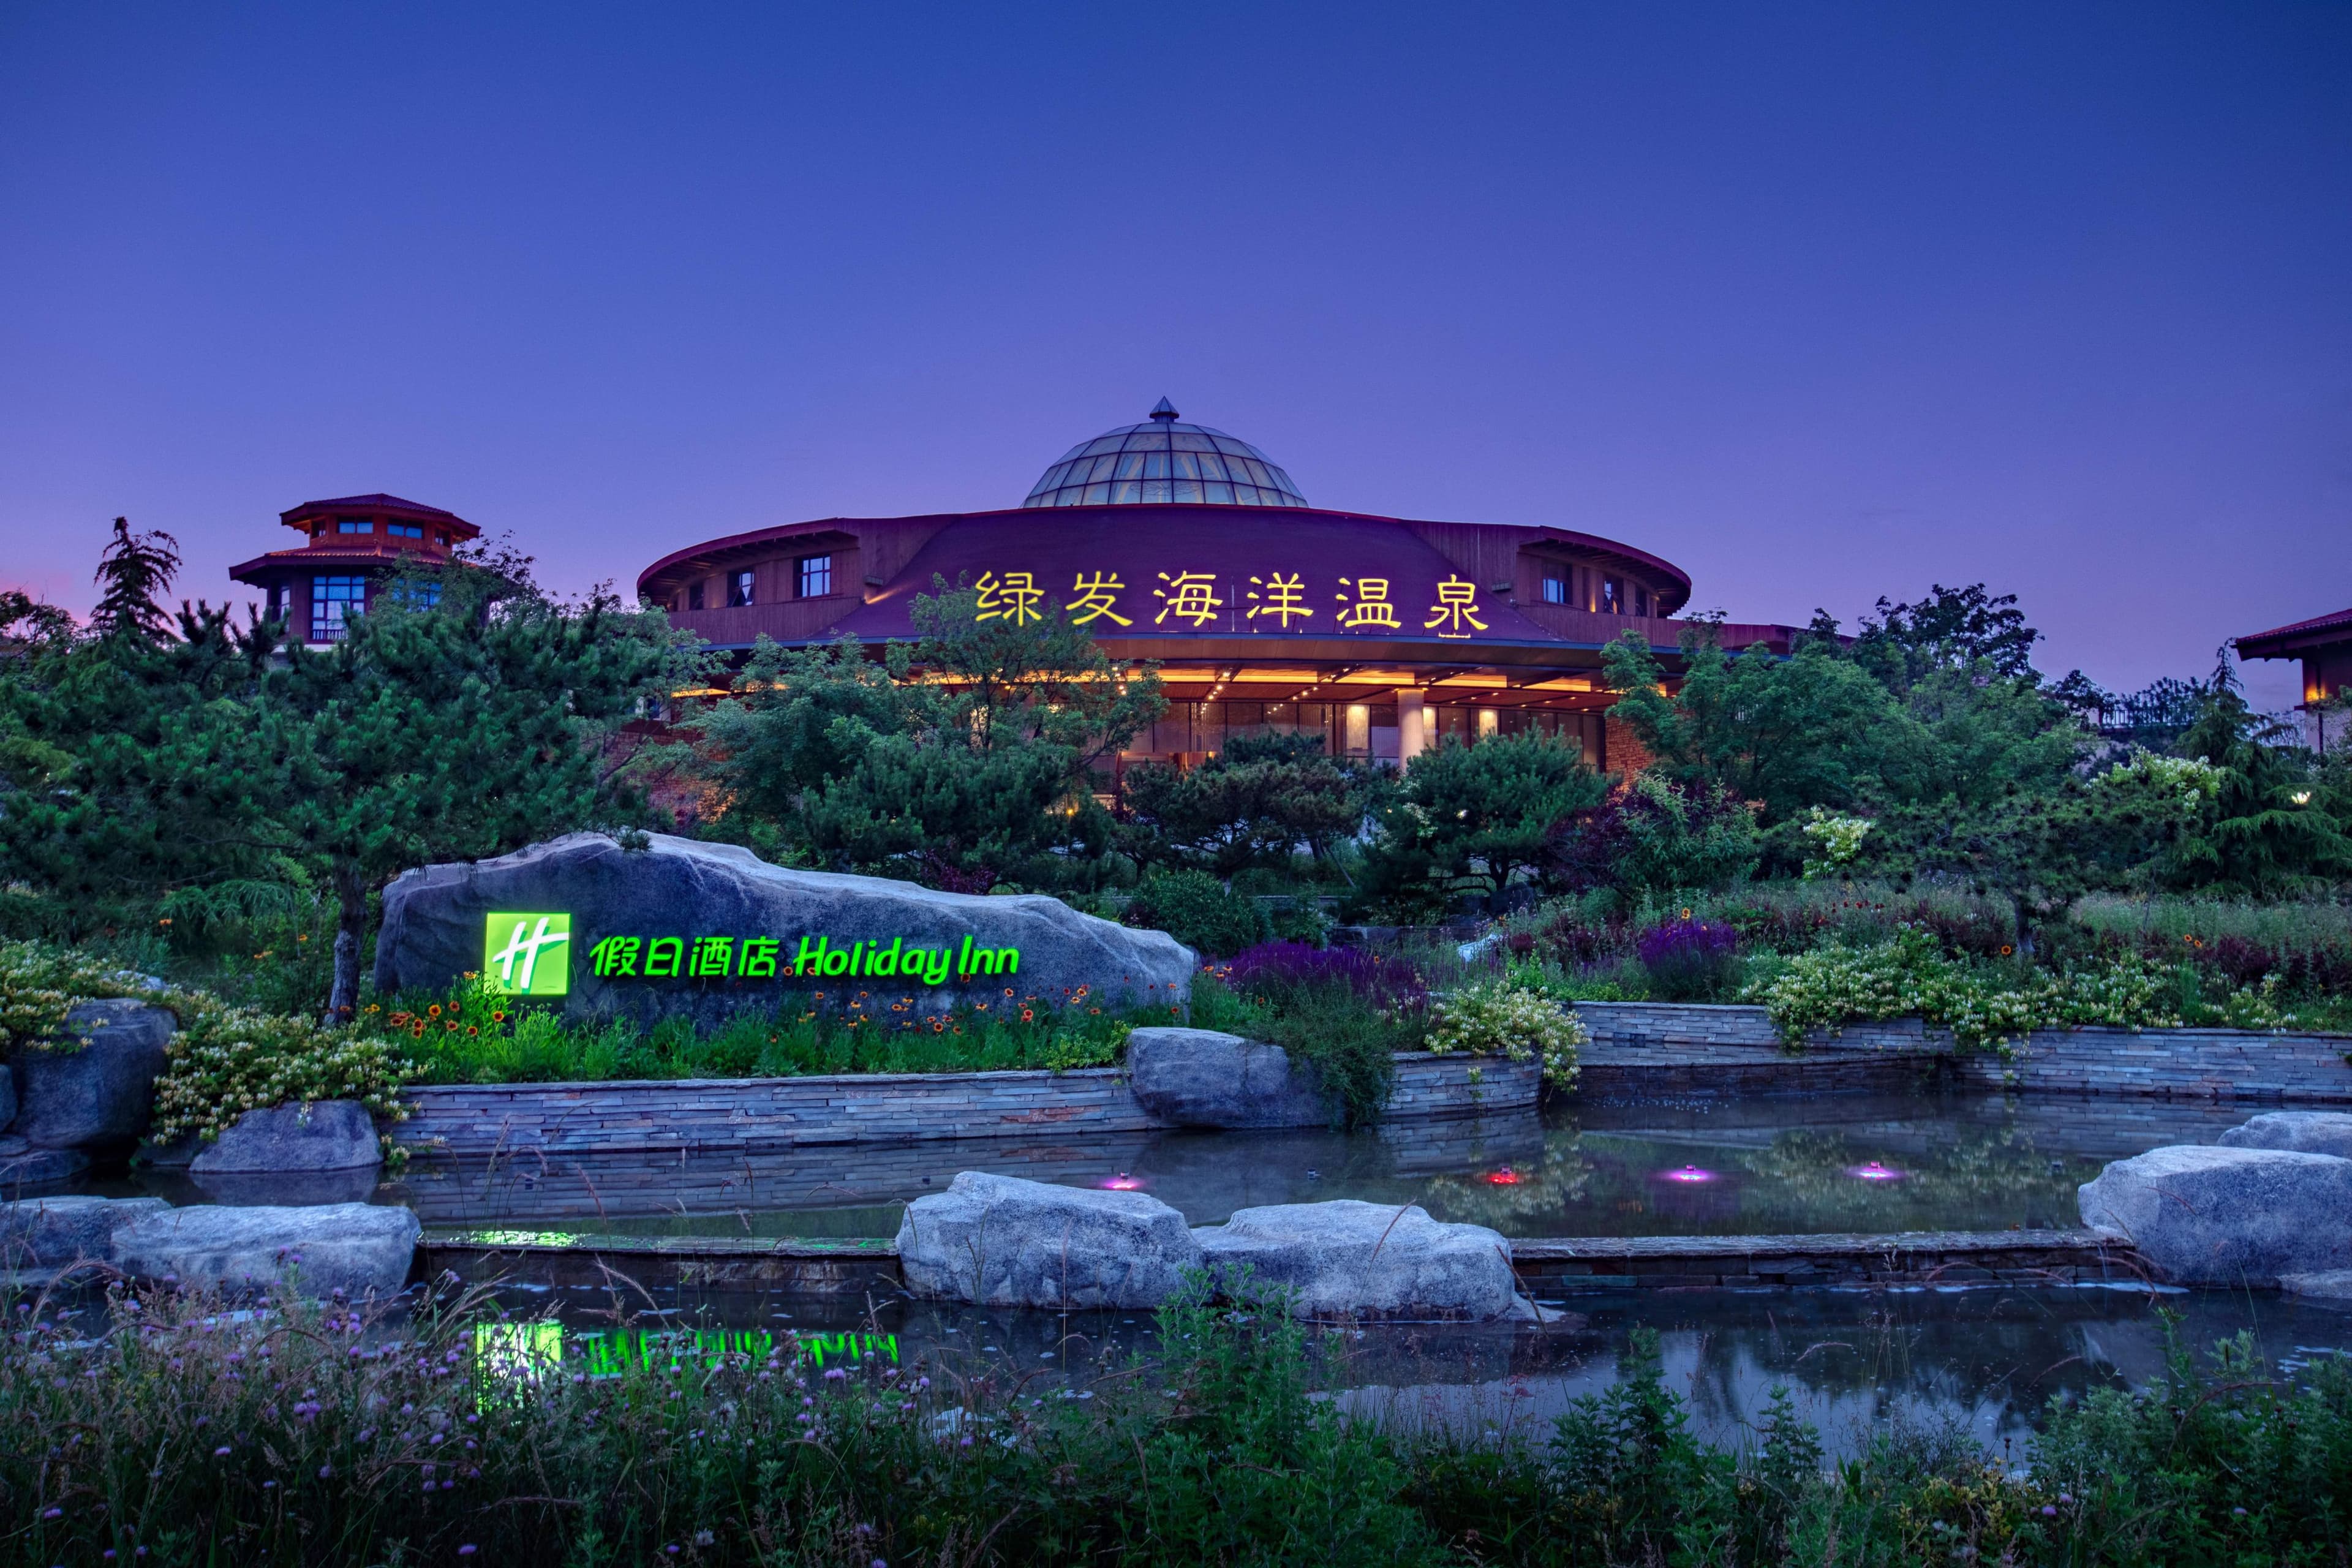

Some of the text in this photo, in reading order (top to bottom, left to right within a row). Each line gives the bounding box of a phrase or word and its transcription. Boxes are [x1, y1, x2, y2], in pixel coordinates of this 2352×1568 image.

[975, 570, 1489, 631] 绿发海洋温泉
[589, 935, 1020, 986] 假日酒店 Holiday Inn
